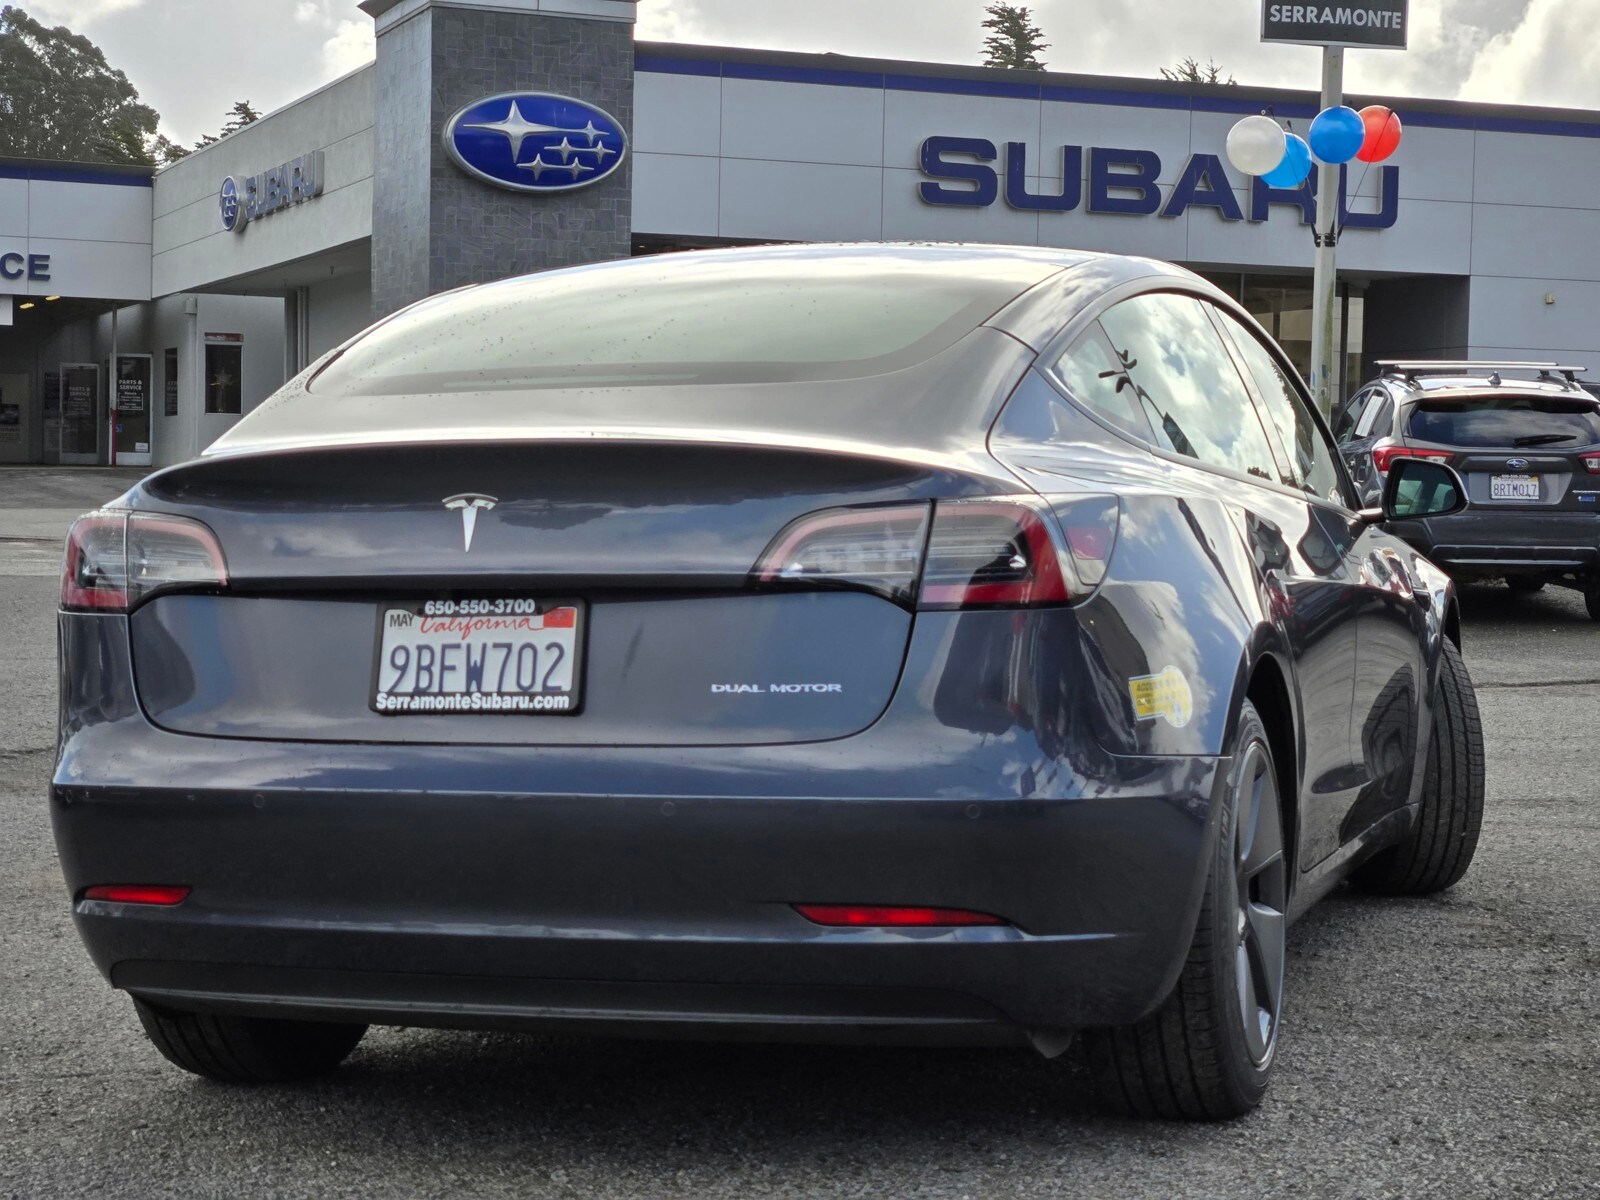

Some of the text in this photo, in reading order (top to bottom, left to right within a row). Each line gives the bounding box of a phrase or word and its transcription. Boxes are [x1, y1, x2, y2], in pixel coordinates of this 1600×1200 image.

[1268, 4, 1402, 29] SERRAMONTE
[245, 150, 322, 221] SUBARU
[919, 135, 1399, 229] SUBARU
[389, 613, 415, 628] MAY
[420, 615, 545, 641] California
[386, 641, 566, 694] 9BFW702
[711, 683, 842, 693] DUAL MOTOR
[376, 692, 570, 710] SerramonteSubaru.com
